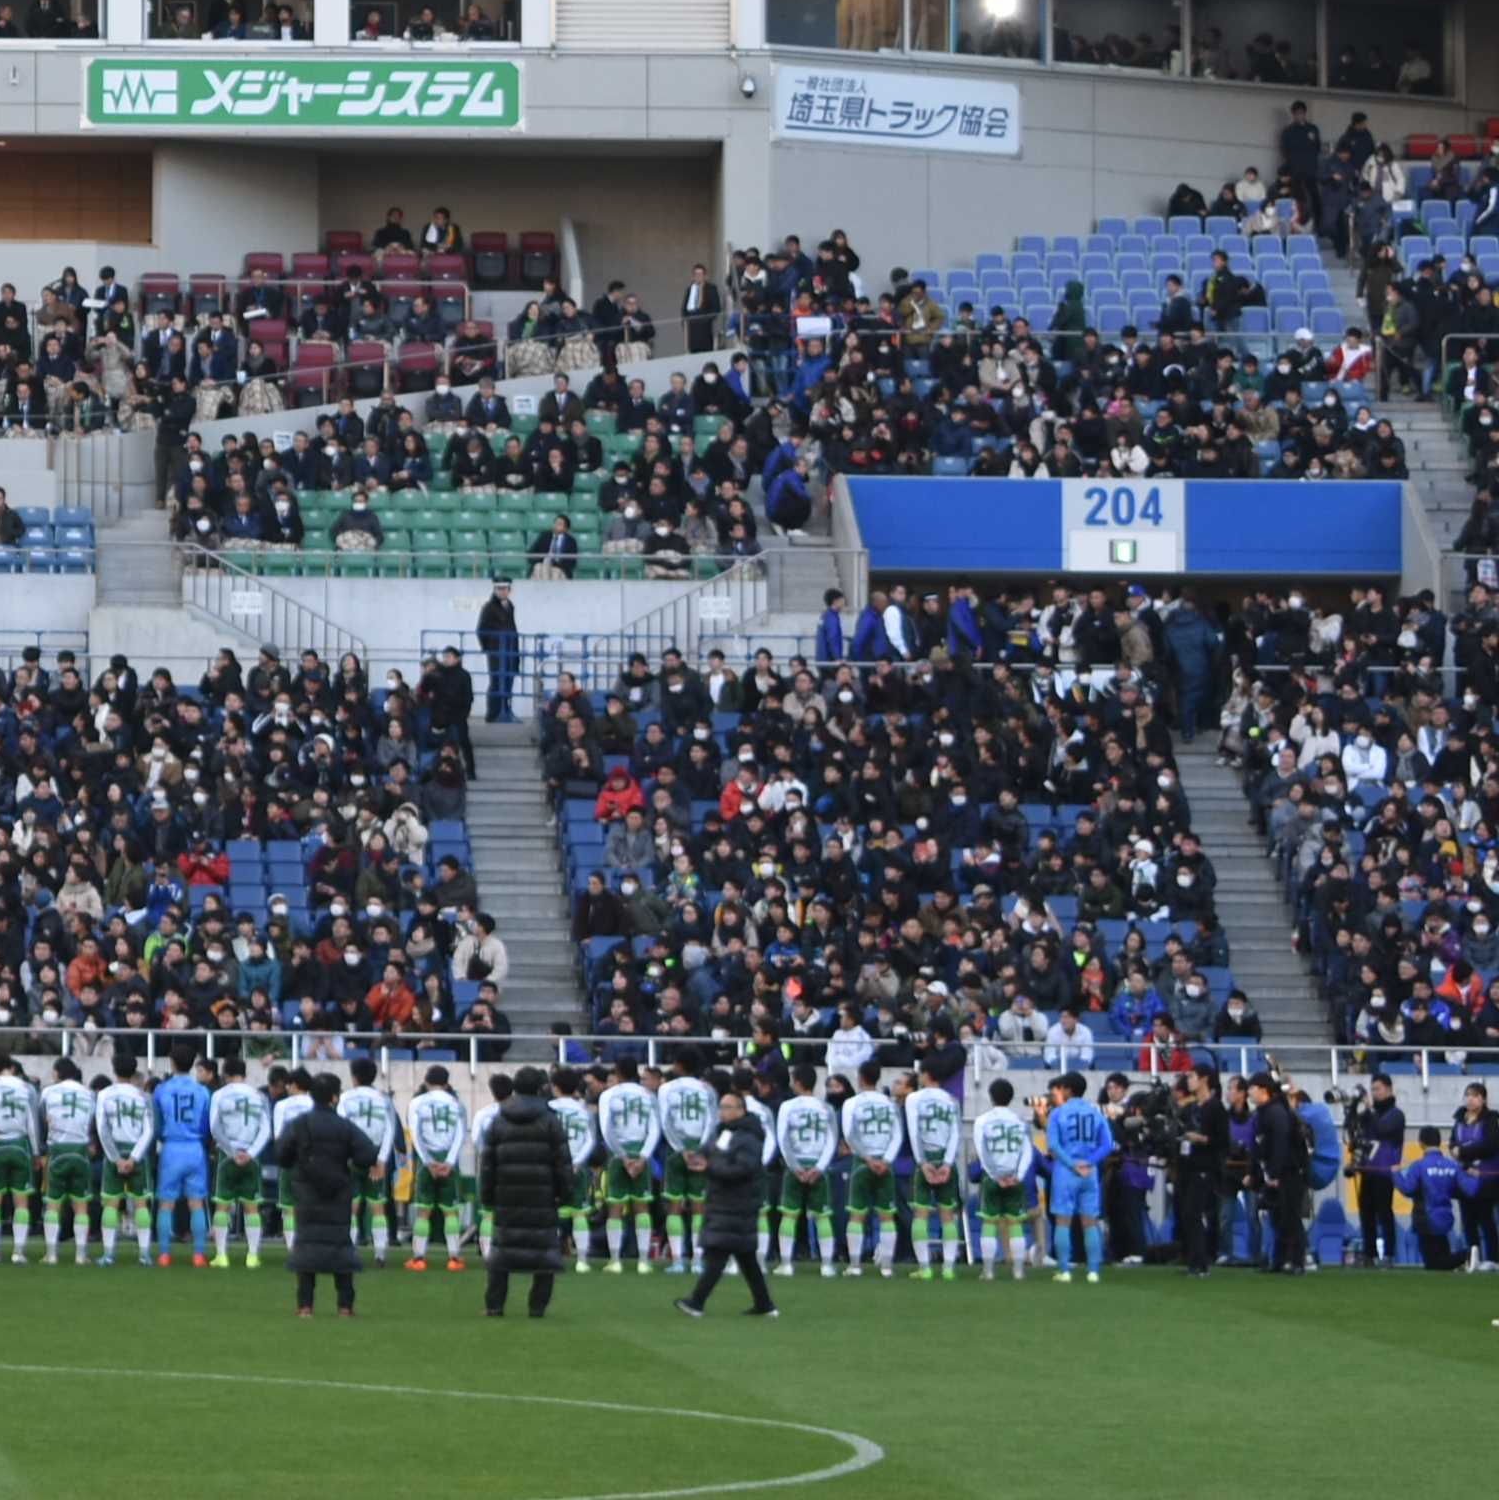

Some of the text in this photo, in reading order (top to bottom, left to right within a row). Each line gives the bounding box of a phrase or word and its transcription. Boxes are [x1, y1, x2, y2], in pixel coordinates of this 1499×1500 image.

[189, 69, 505, 117] メジャーシステム
[786, 91, 1010, 139] 埼玉県トラック協会
[1083, 486, 1164, 527] 204
[171, 1092, 195, 1123] 12
[1067, 1112, 1096, 1143] 30
